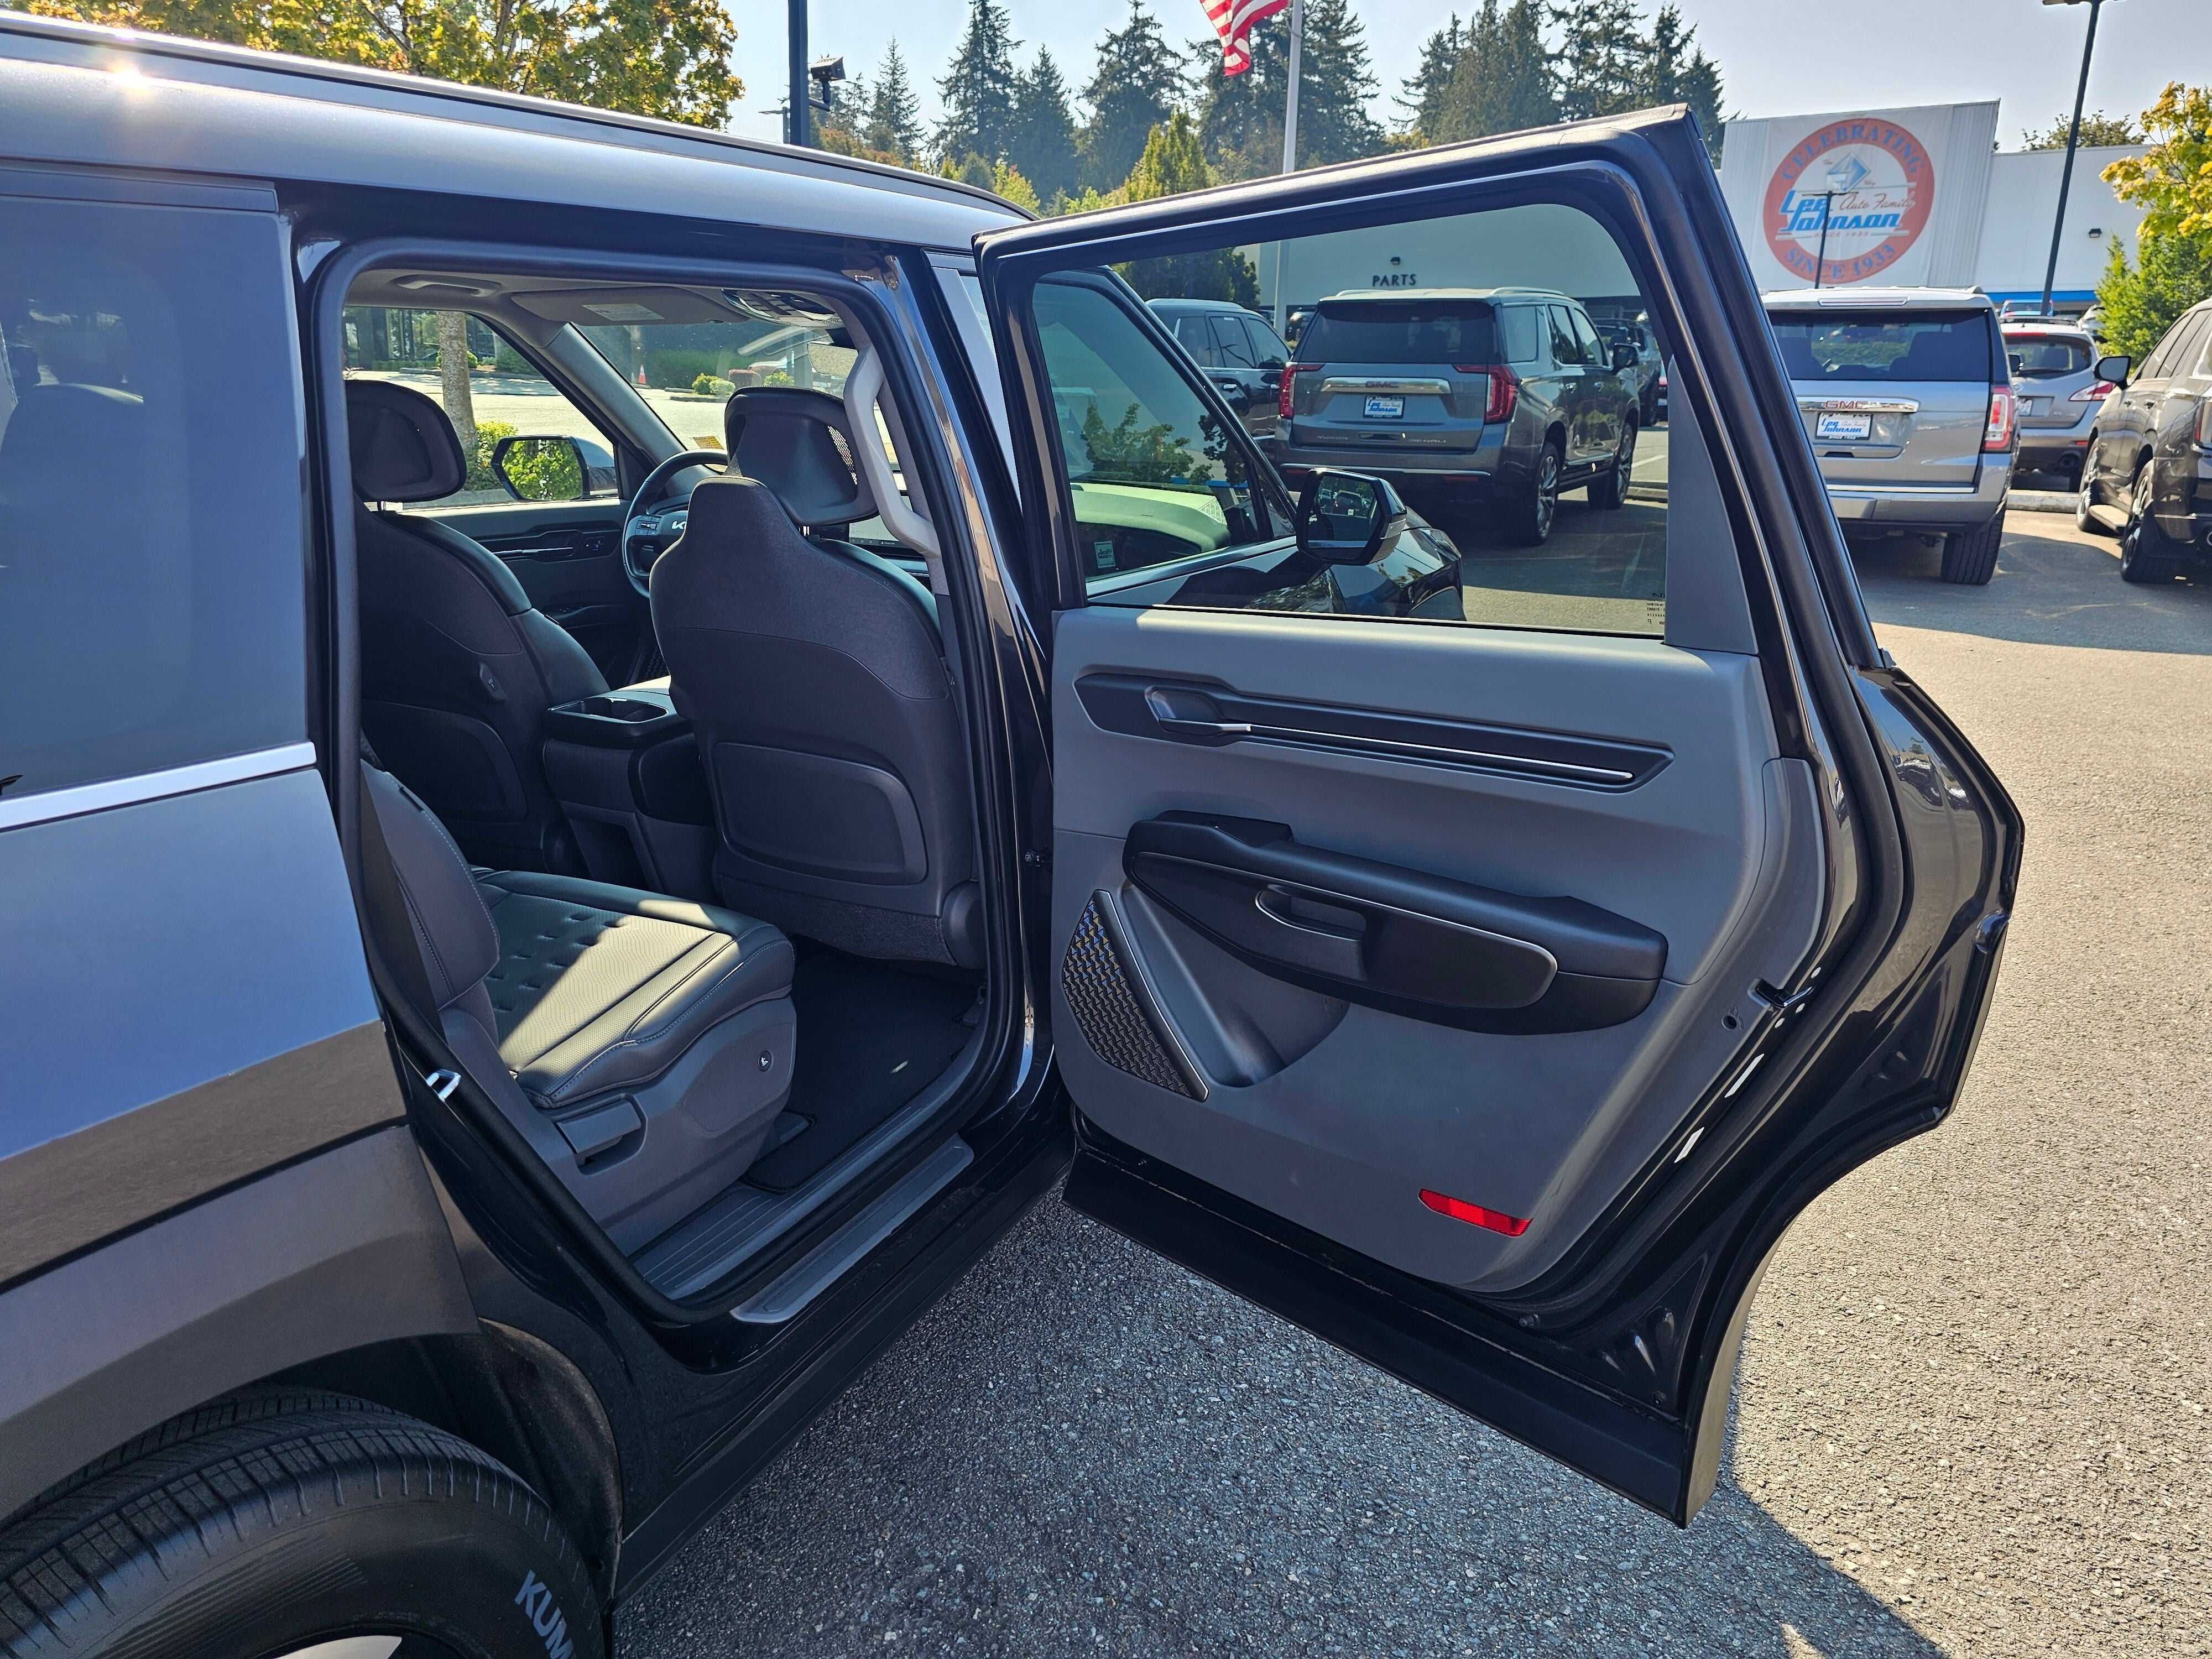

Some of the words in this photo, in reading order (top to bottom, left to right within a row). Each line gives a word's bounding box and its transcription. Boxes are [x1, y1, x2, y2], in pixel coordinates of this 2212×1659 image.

[1781, 123, 1924, 180] CELEBRATING
[1780, 190, 1834, 213] Lee
[1839, 191, 1870, 211] Auto
[1872, 193, 1916, 211] Family
[1780, 207, 1901, 232] Johnson
[1784, 248, 1845, 279] SINCE
[1853, 243, 1896, 276] 1933
[1373, 273, 1417, 286] PARTS
[1825, 400, 1868, 409] GMC
[1821, 424, 1862, 433] Johnson
